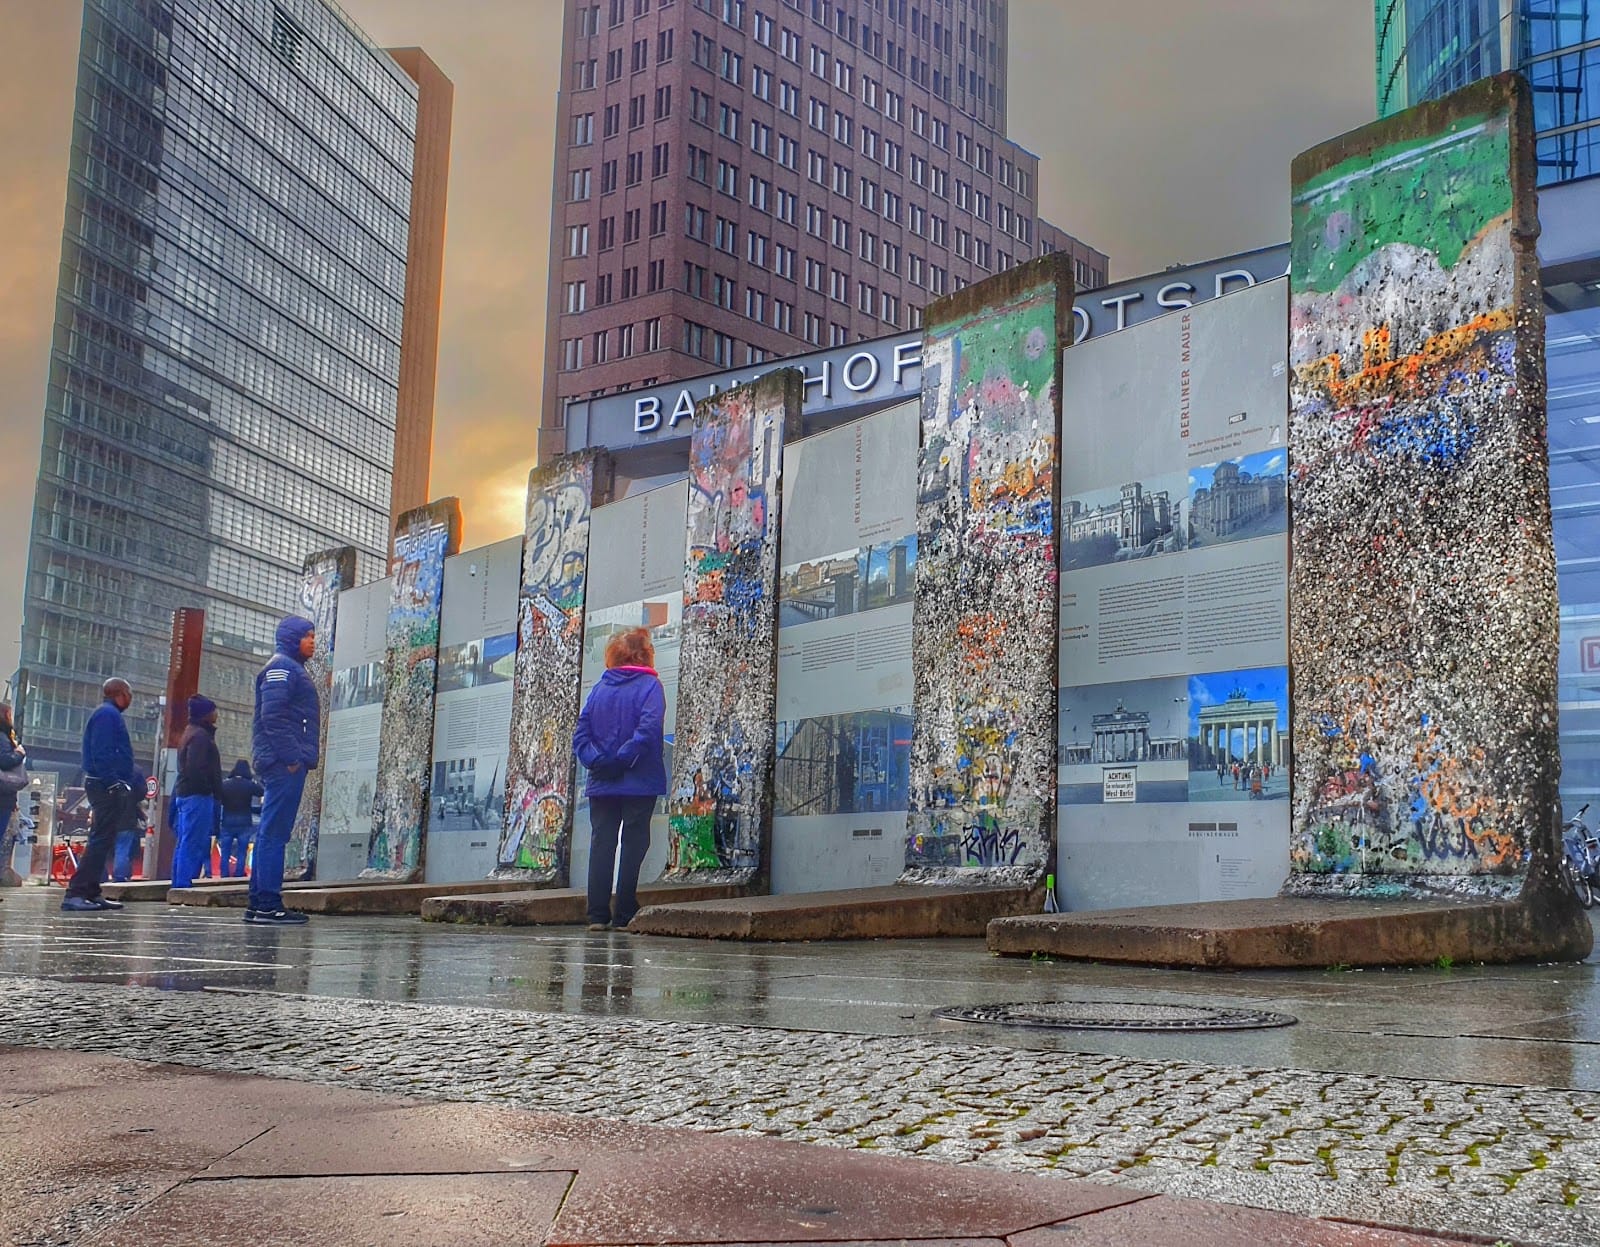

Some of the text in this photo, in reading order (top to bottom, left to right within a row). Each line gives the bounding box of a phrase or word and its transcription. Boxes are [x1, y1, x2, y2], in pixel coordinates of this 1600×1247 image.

[633, 340, 922, 433] BAHOF
[1180, 312, 1191, 439] BERLINER MAUER
[853, 424, 863, 524] BERLINER MAUER
